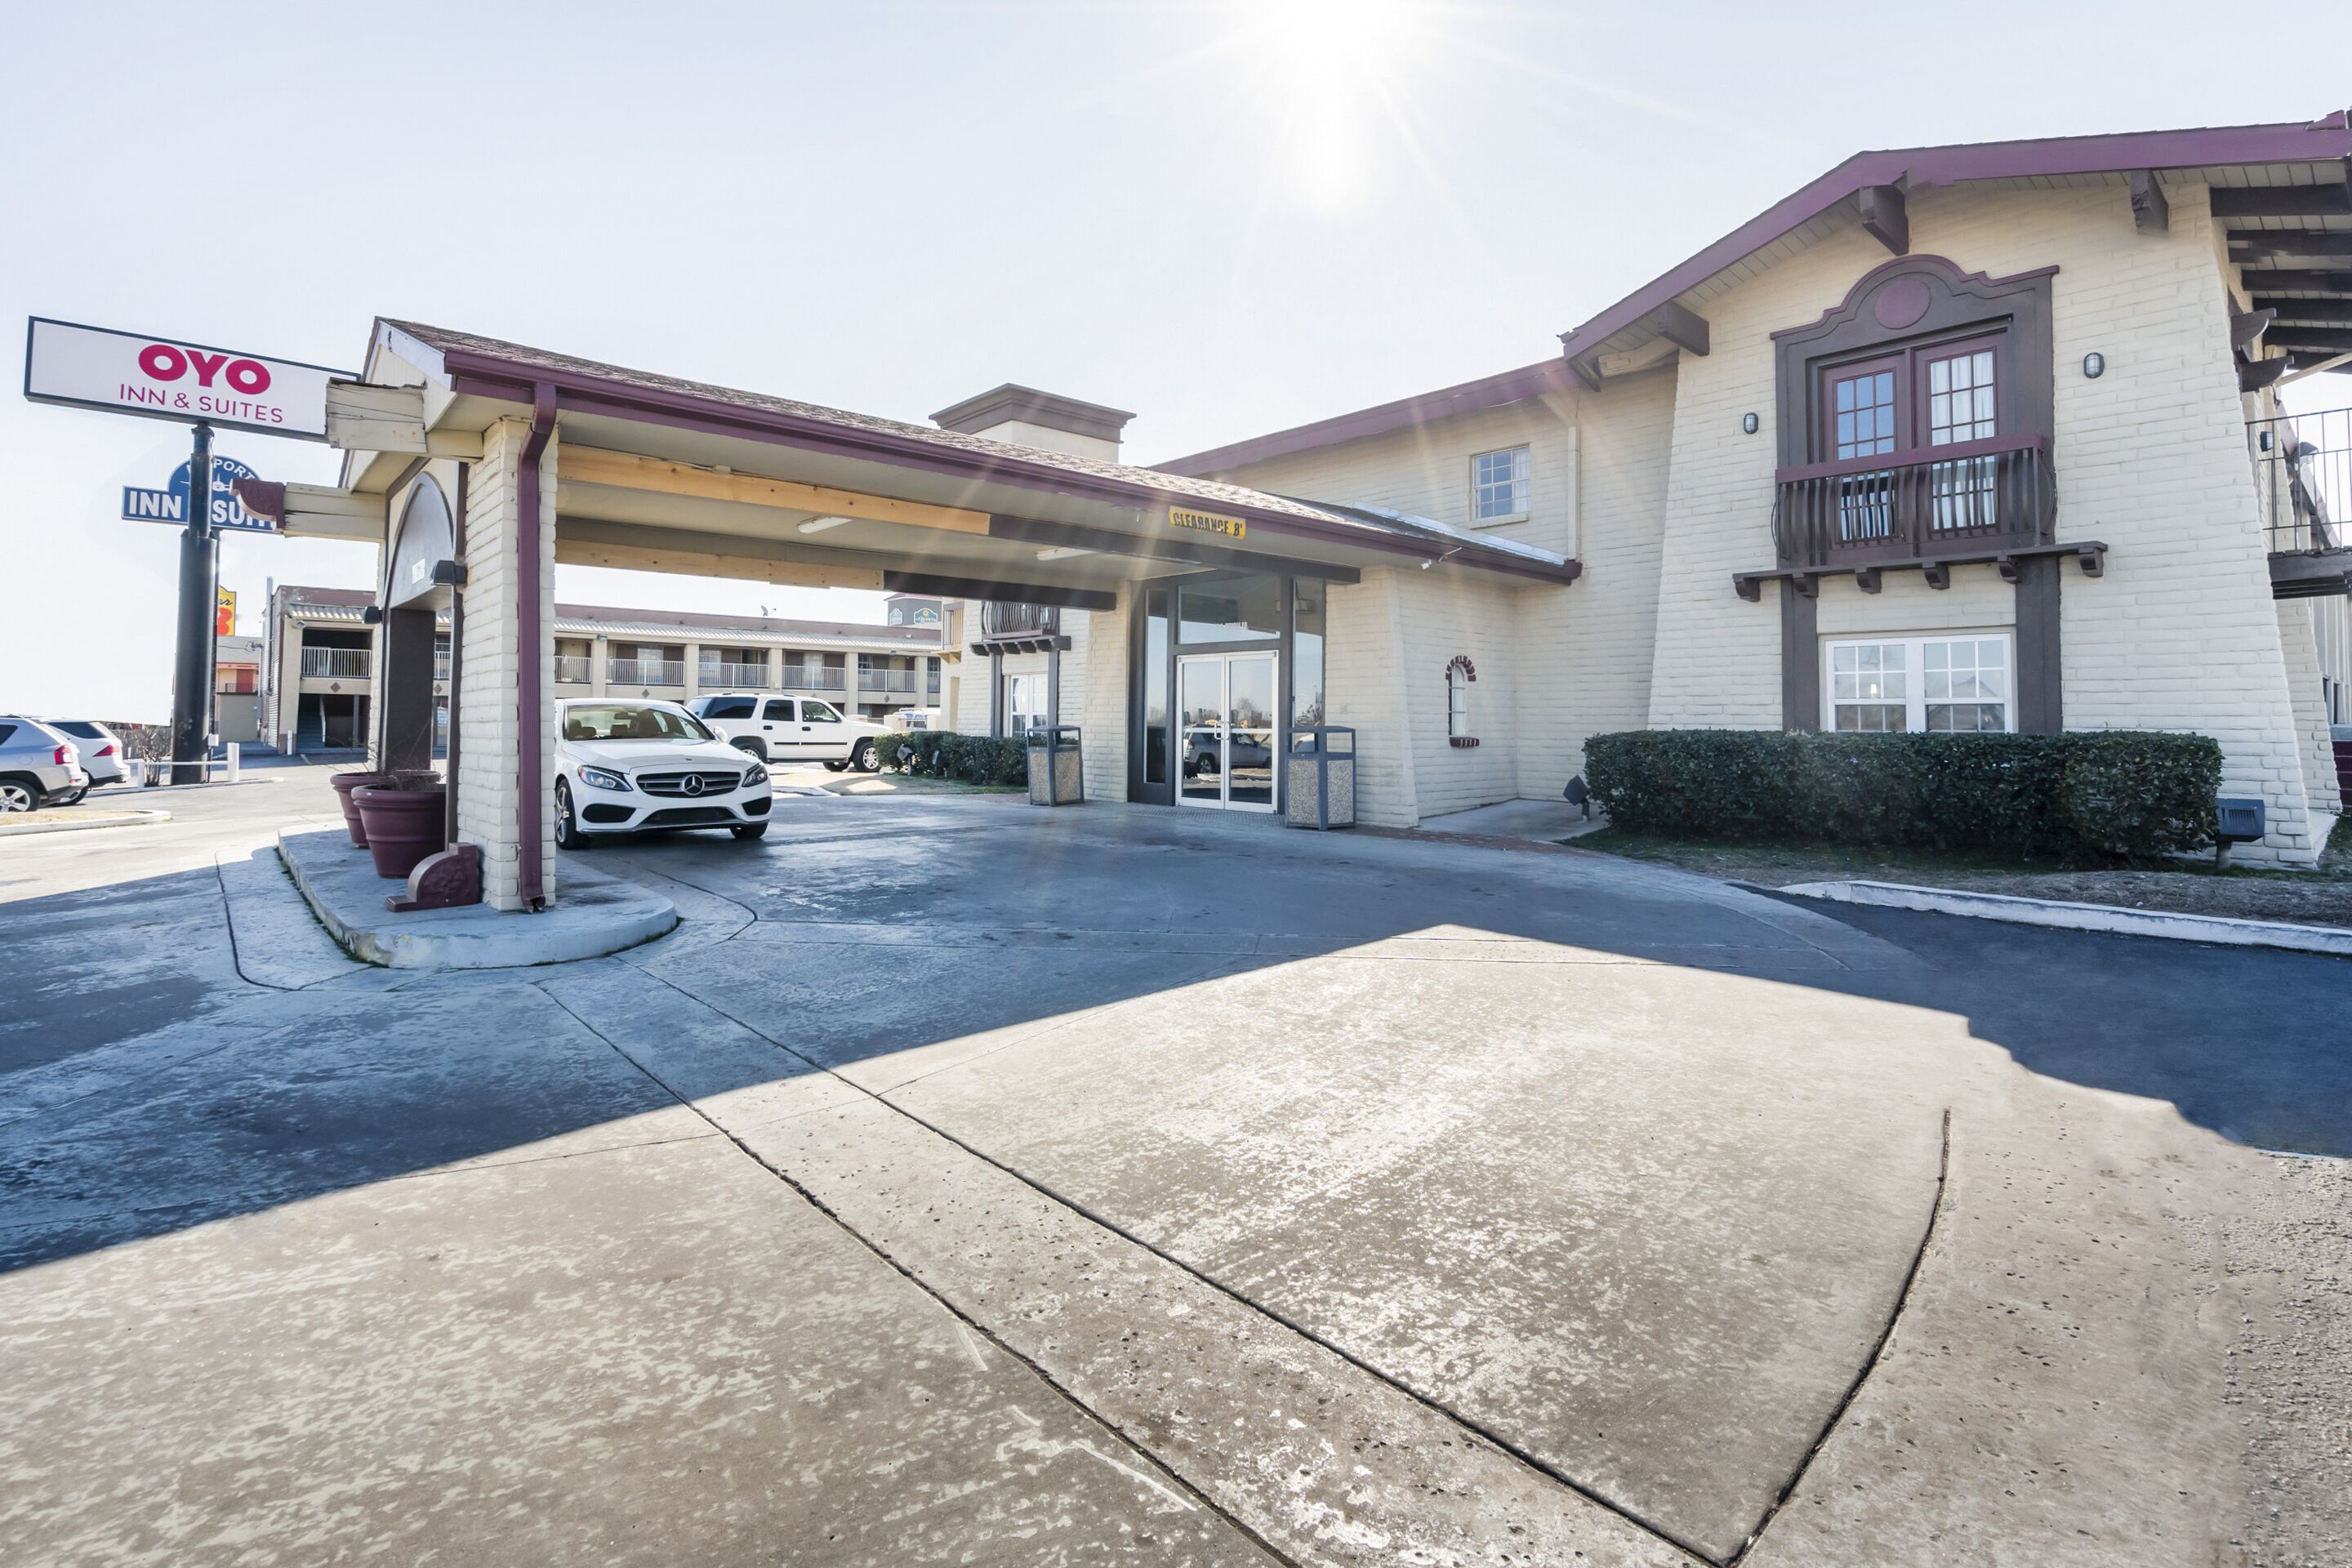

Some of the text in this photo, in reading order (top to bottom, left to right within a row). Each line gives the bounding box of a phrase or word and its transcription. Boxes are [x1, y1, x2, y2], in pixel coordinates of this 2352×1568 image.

[138, 344, 271, 395] OYO
[120, 384, 283, 423] INN & SUITES
[129, 491, 181, 519] INN
[1173, 512, 1228, 534] CLEARANCE
